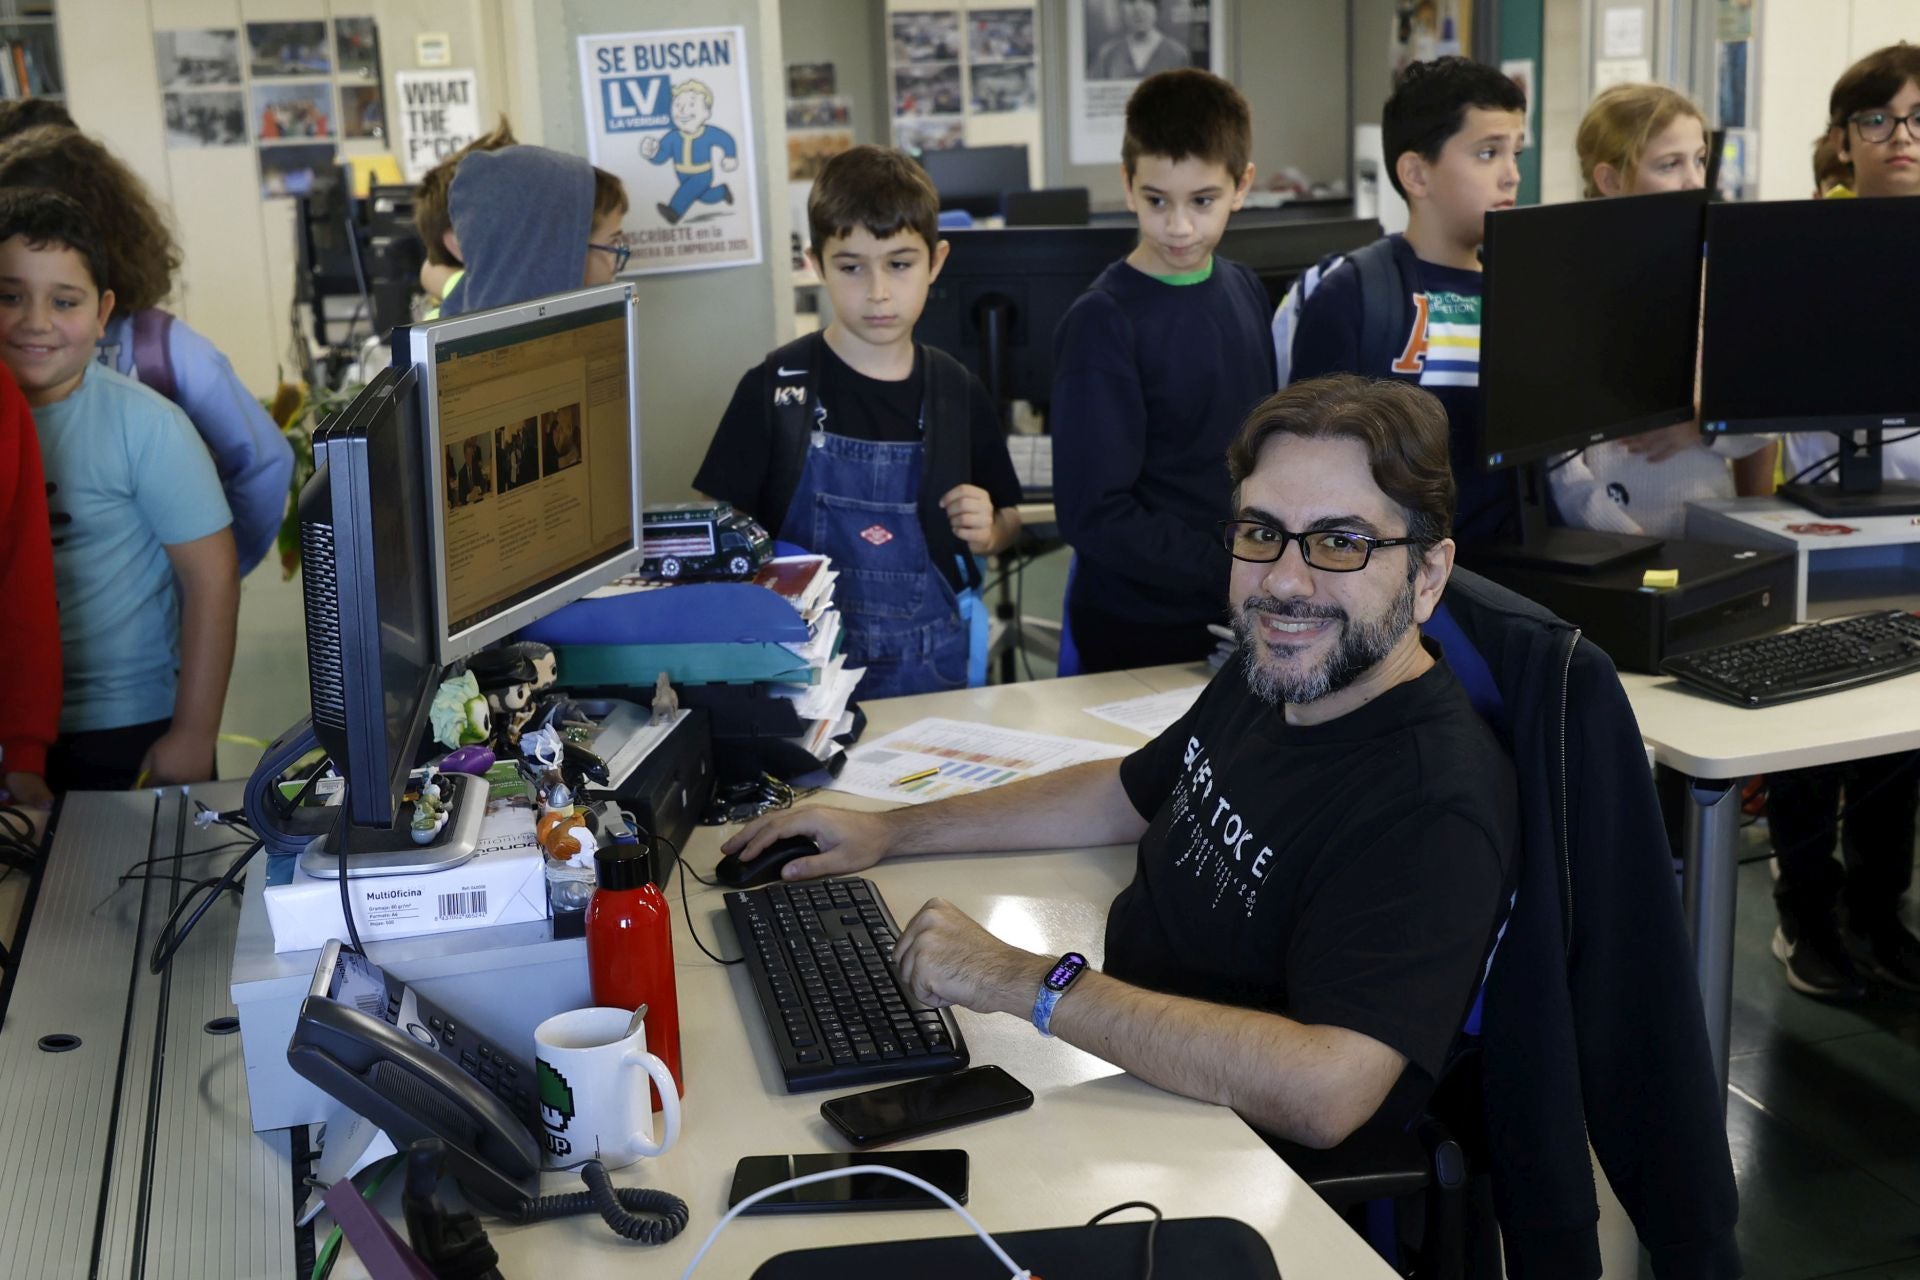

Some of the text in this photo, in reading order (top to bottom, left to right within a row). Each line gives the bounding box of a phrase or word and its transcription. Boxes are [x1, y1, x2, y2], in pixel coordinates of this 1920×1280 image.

[597, 39, 731, 74] SE BUSCAN
[403, 81, 469, 104] WHAT
[608, 78, 662, 118] LV
[408, 110, 449, 133] THE
[609, 115, 671, 130] LA VERDAD
[696, 229, 709, 240] en
[712, 225, 723, 238] la
[663, 245, 676, 257] DE
[366, 889, 422, 900] MultiOficina
